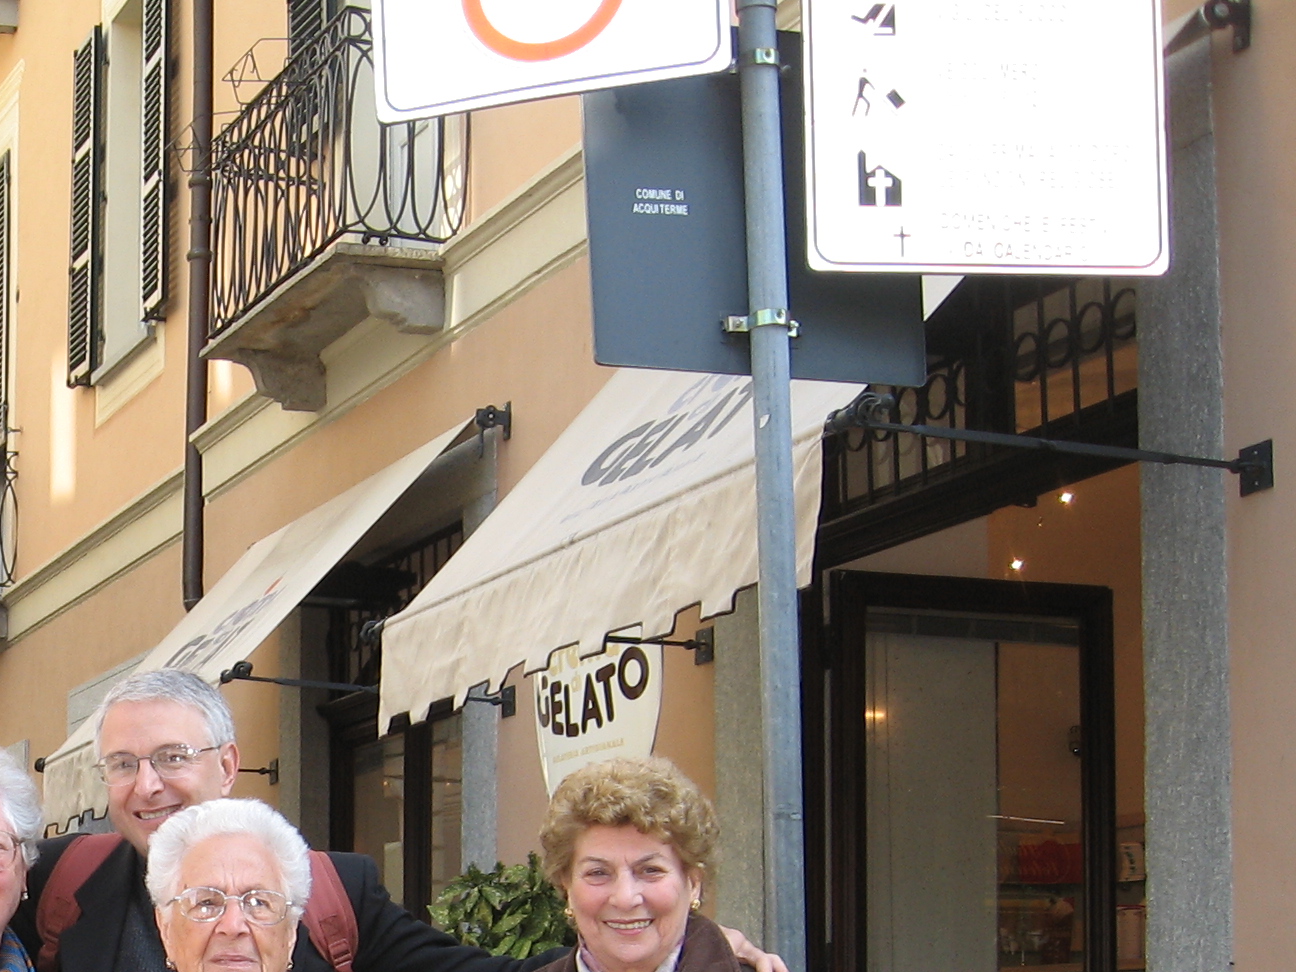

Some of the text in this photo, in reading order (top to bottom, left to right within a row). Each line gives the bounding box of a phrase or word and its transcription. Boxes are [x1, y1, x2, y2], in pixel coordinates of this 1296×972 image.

[635, 188, 684, 200] COMUNE DI
[537, 646, 649, 738] GELATO
